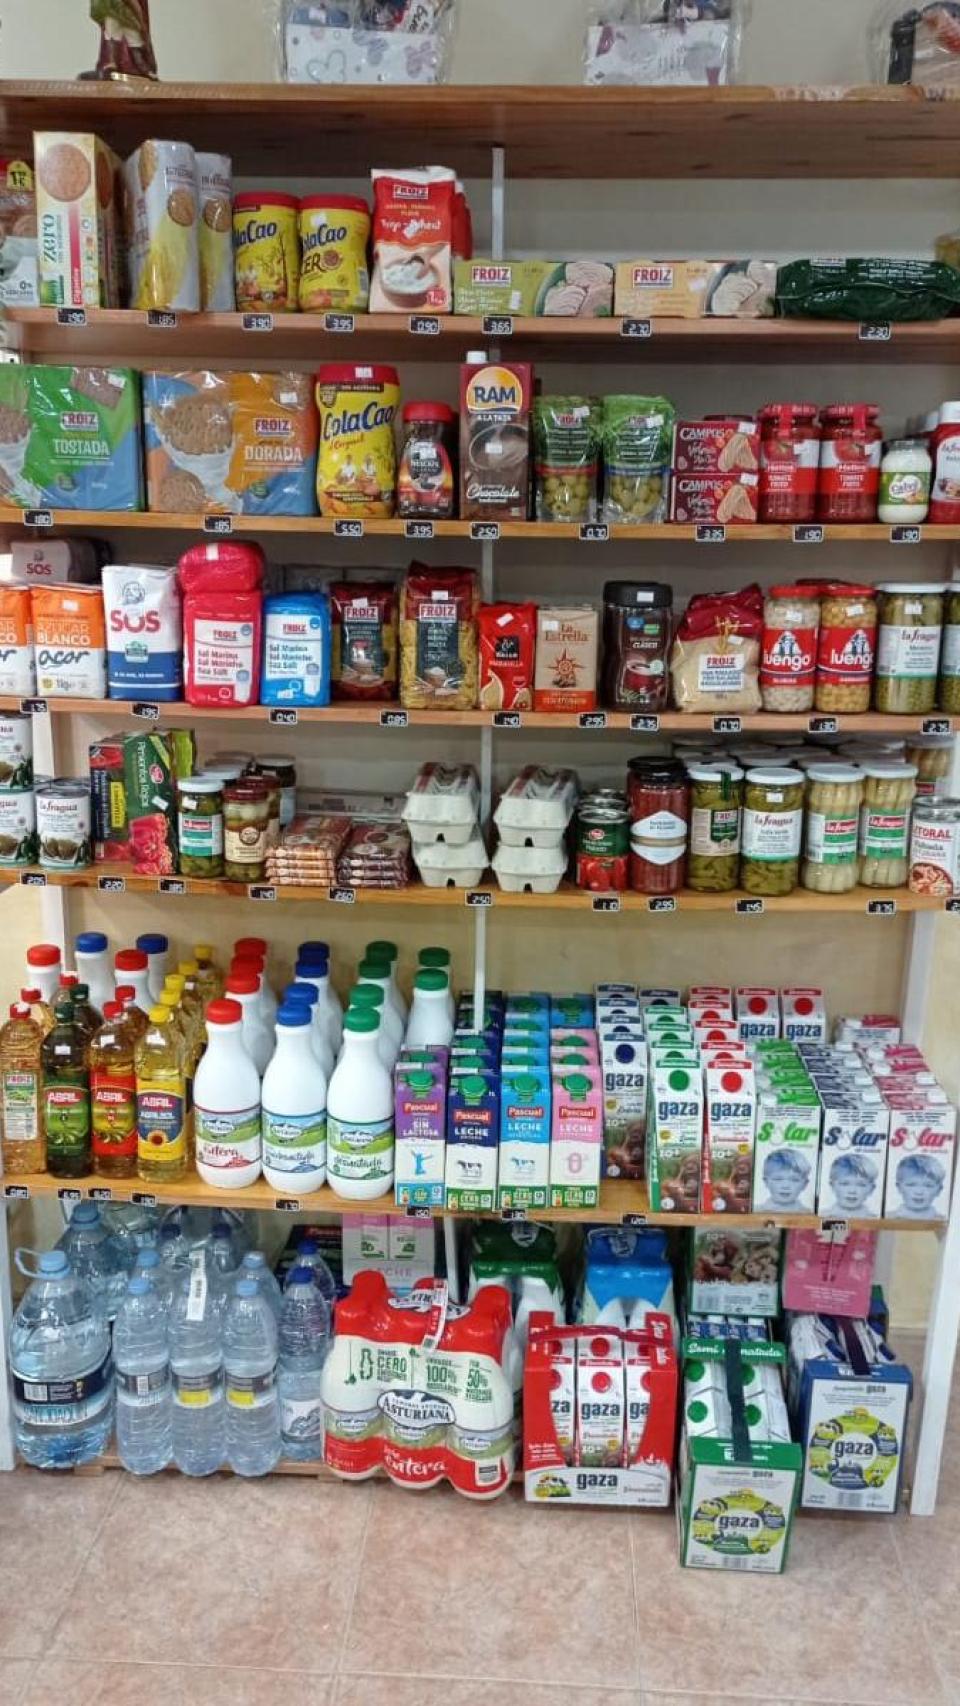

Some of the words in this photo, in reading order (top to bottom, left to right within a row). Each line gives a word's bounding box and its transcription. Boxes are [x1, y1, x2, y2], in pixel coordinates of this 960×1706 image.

[473, 268, 511, 281] FROIZ
[634, 268, 672, 282] FROIZ
[474, 386, 516, 403] RAM
[255, 419, 291, 432] FROIZ
[323, 401, 395, 441] ColaCao
[679, 427, 724, 440] CAMPOS
[53, 439, 111, 455] TOSTADA
[245, 446, 304, 462] DORADA
[679, 479, 724, 492] CAMPOS
[26, 563, 52, 575] SOS
[346, 607, 377, 617] FROIZ
[420, 604, 456, 617] FROIZ
[110, 610, 161, 633] SOS
[283, 624, 307, 633] FROIZ
[36, 633, 92, 645] BLANCO
[545, 629, 590, 642] Estrella
[38, 650, 90, 666] acor
[763, 652, 811, 670] luengo
[740, 1023, 776, 1040] gaza
[786, 1023, 822, 1040] gaza
[605, 1073, 645, 1091] gaza
[48, 1091, 81, 1102] ABRIL
[97, 1091, 126, 1102] ABRIL
[142, 1097, 173, 1107] ABRIL
[405, 1102, 438, 1112] Pascual
[508, 1107, 542, 1118] Pascual
[561, 1109, 595, 1119] Pascual
[658, 1101, 699, 1121] gaza
[711, 1103, 752, 1122] gaza
[455, 1111, 490, 1122] Pascual
[414, 1121, 429, 1129] SIN
[508, 1122, 542, 1131] LECHE
[559, 1124, 593, 1133] LECHE
[402, 1129, 439, 1137] LACTOSA
[455, 1128, 490, 1137] LECHE
[377, 1356, 407, 1373] CERO
[426, 1364, 457, 1384] 100%
[467, 1368, 489, 1389] 50%
[383, 1397, 450, 1420] ASTURIANA
[551, 1399, 570, 1413] za
[581, 1402, 620, 1420] gaza
[629, 1401, 650, 1419] ga
[834, 1439, 874, 1457] gaza
[576, 1473, 618, 1489] gaza
[717, 1515, 760, 1529] gaza
